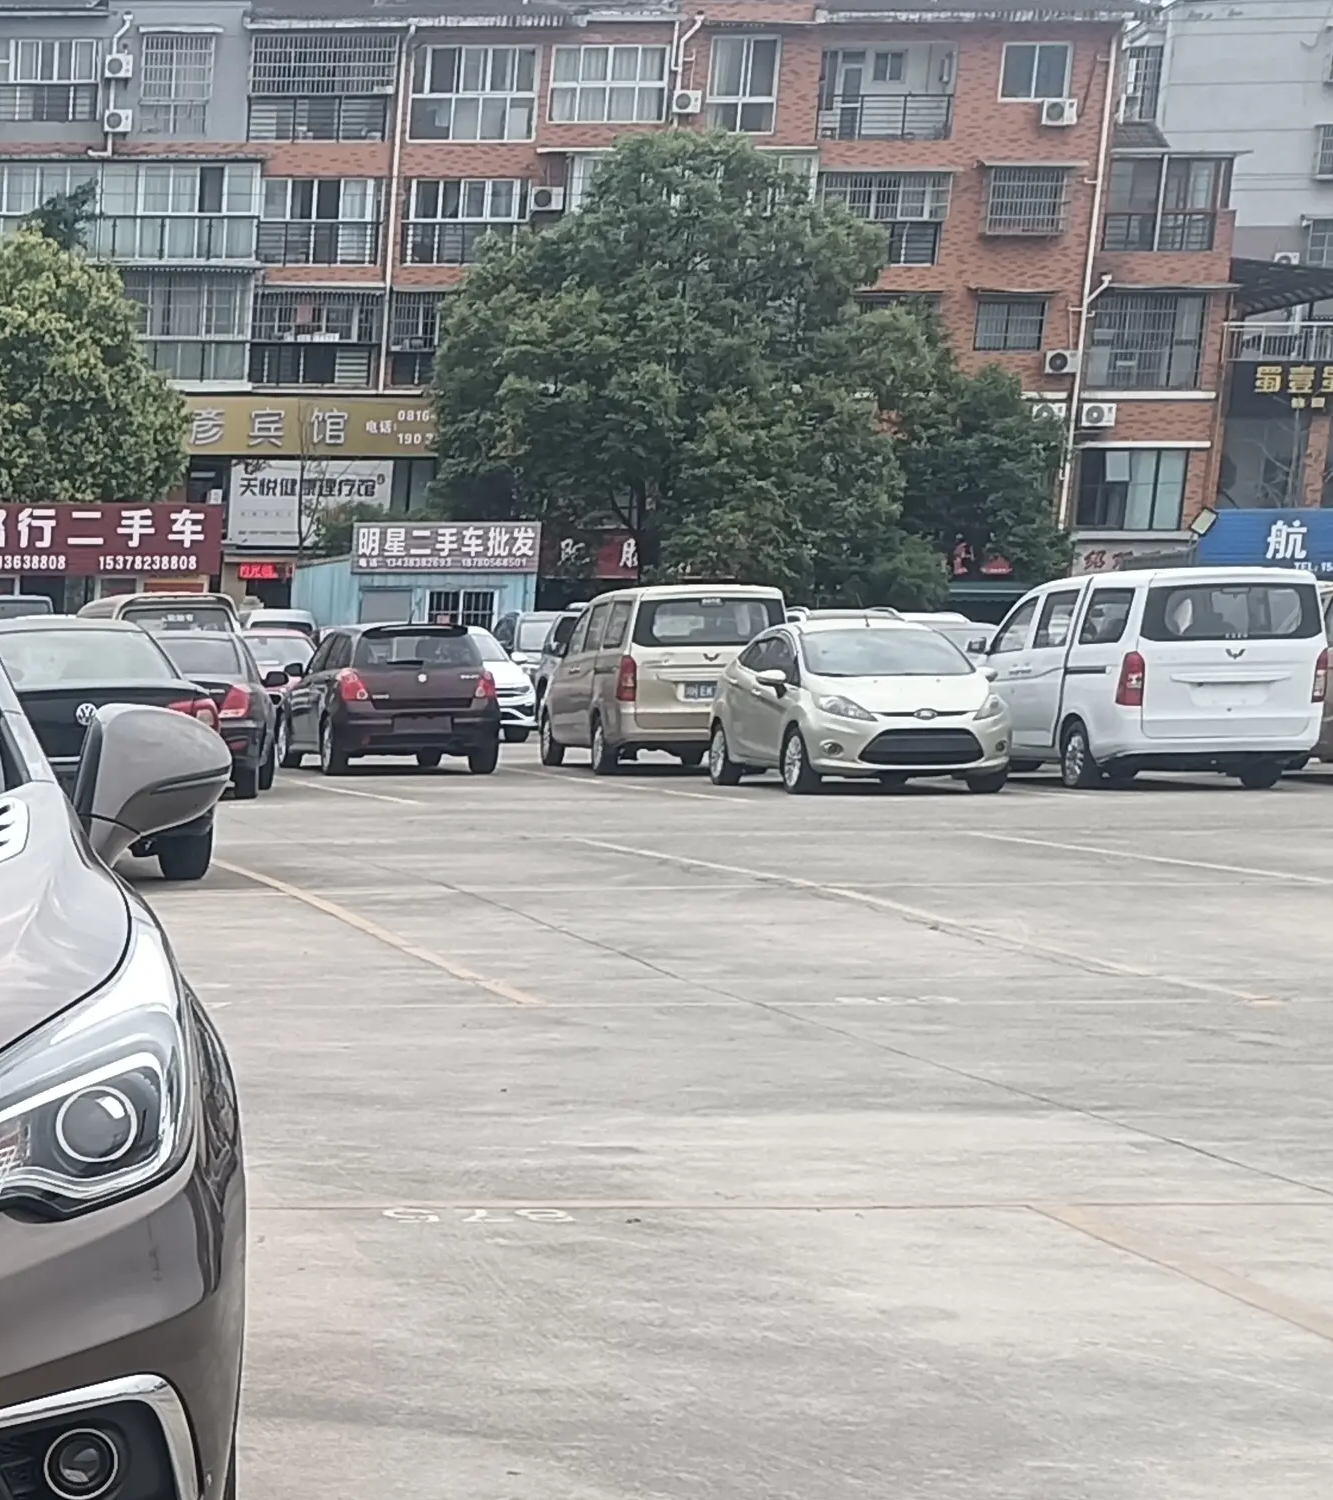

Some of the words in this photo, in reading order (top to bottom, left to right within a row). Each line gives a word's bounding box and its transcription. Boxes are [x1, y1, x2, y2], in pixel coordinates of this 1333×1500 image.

[358, 527, 535, 556] 明星二手车批发
[1265, 519, 1307, 559] 航
[99, 556, 197, 571] 15378238808
